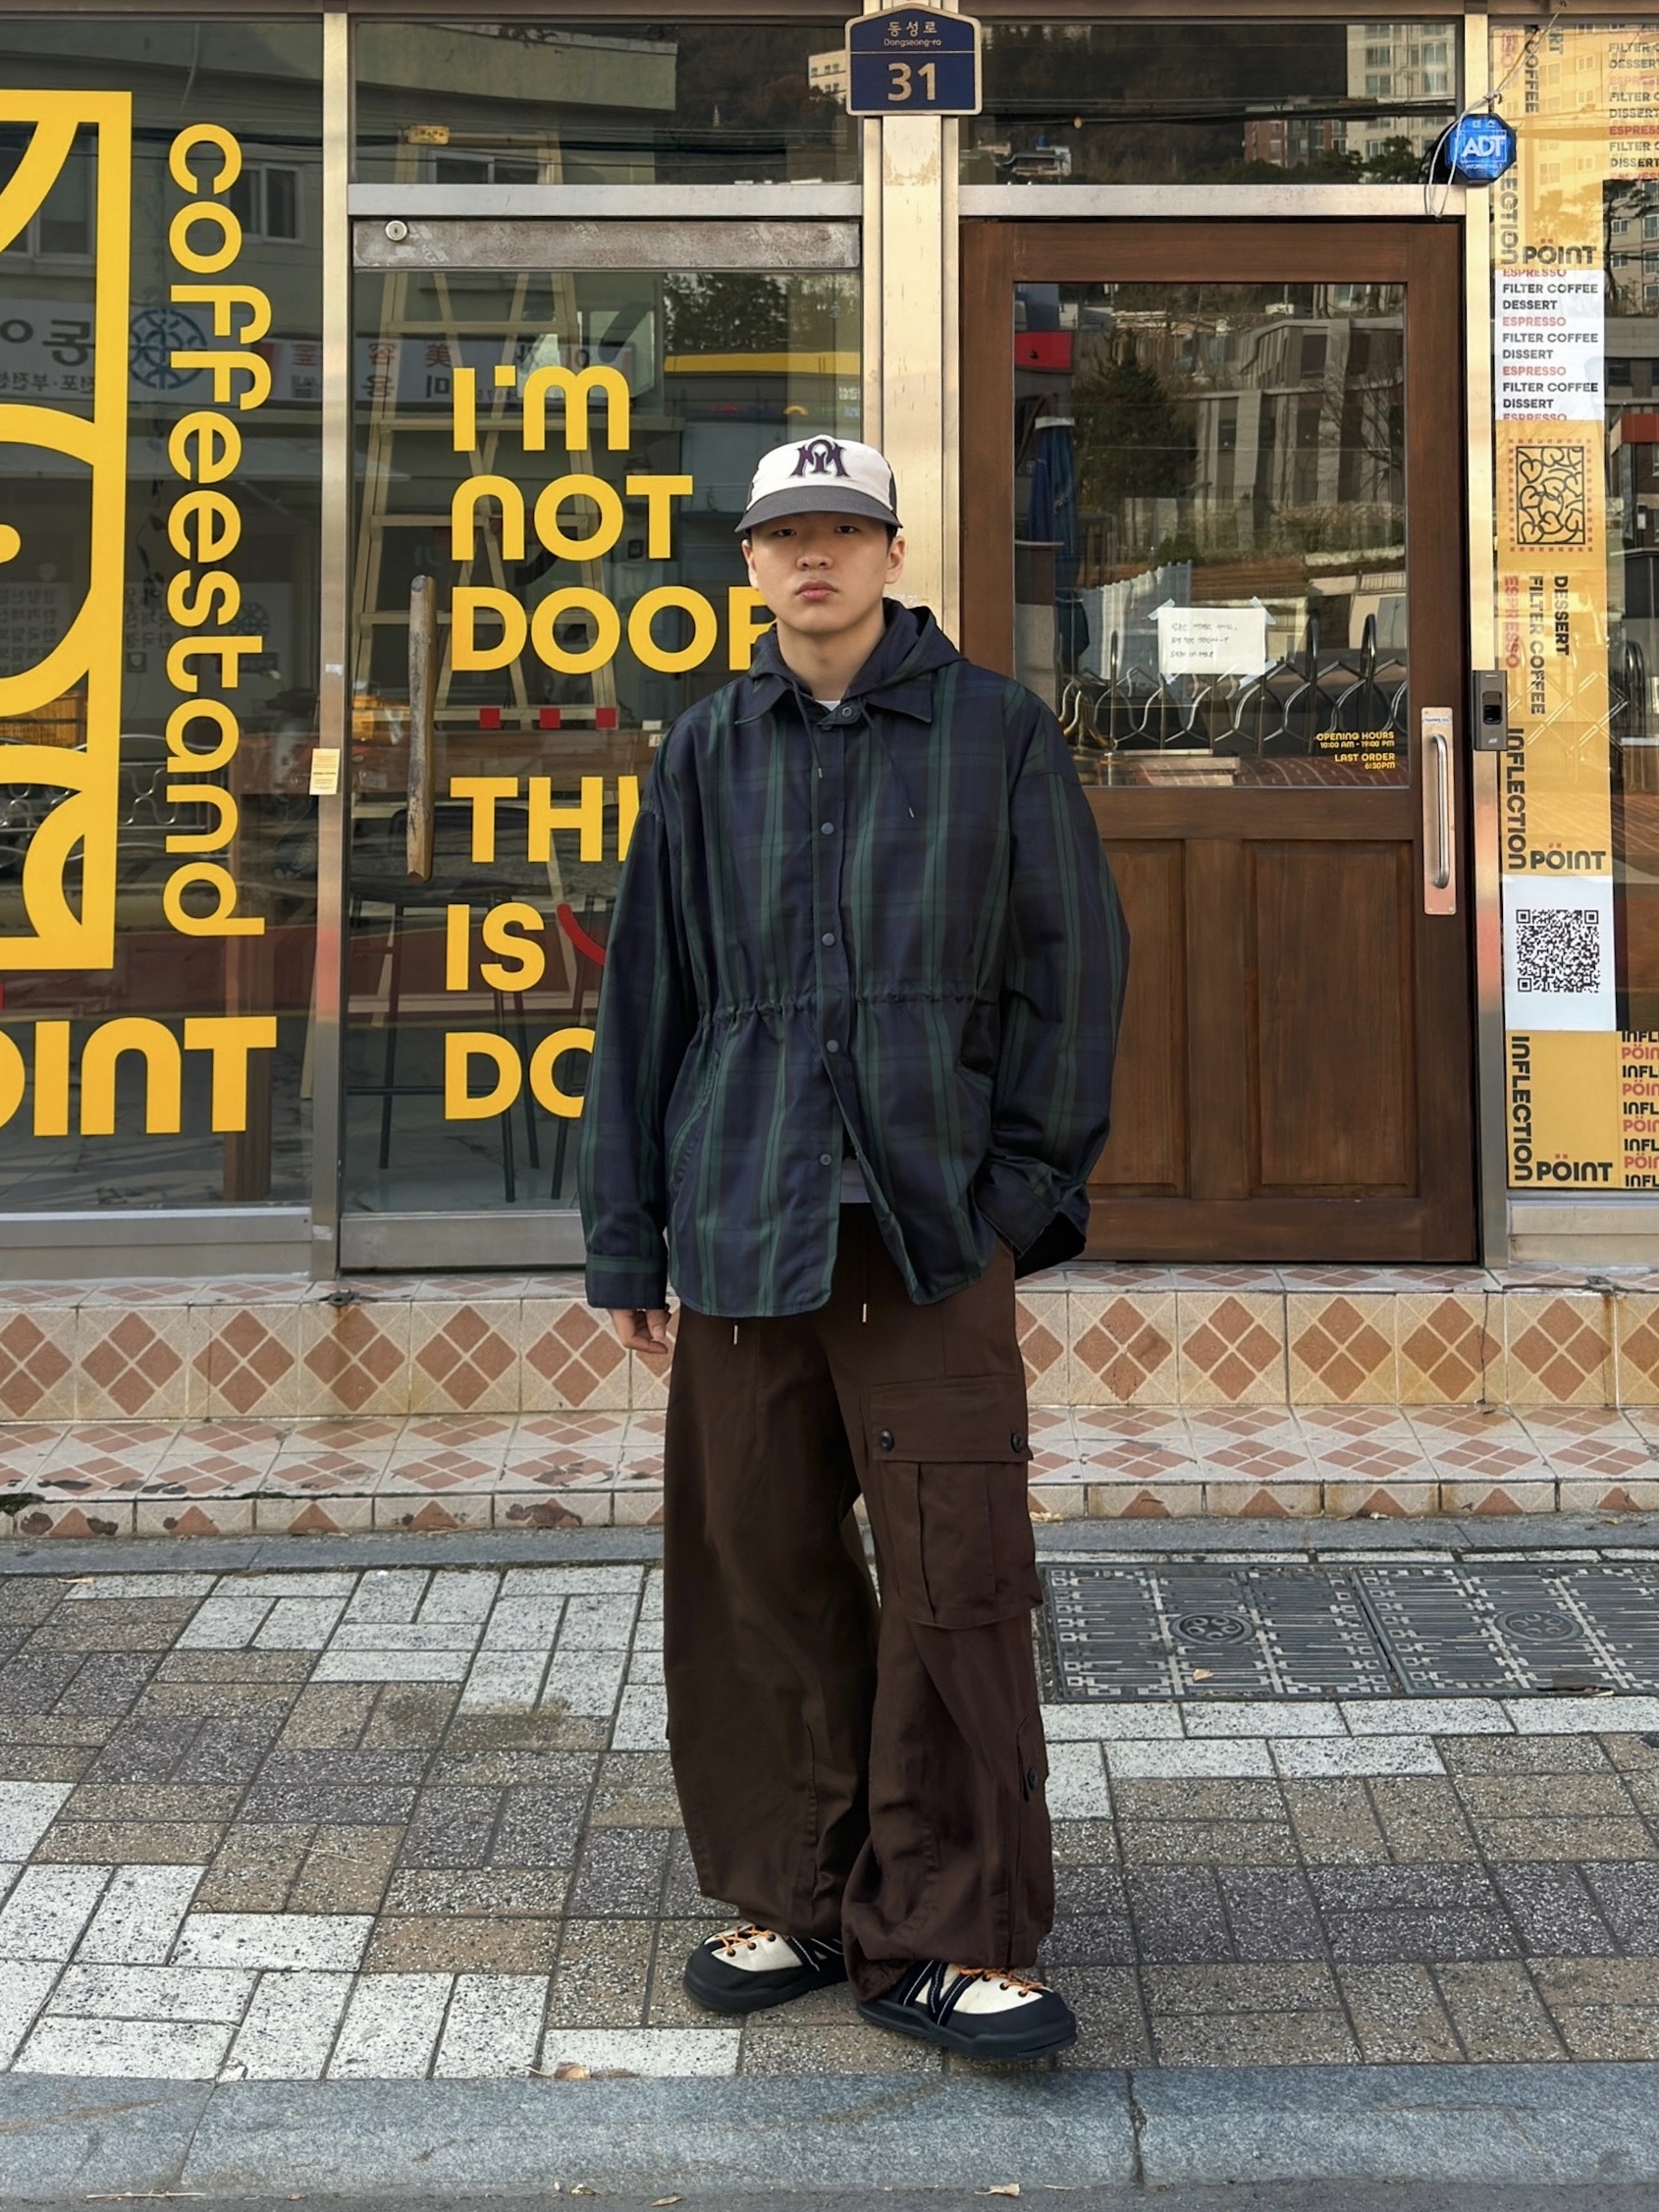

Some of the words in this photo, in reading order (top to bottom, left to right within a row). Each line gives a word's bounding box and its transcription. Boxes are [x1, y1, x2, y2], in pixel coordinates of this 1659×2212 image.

[887, 21, 937, 37] 동성로
[883, 38, 942, 48] Dongseong-ro
[887, 62, 937, 102] 31
[1609, 92, 1650, 102] FILTER
[1609, 125, 1659, 135] ESPRESS
[1461, 135, 1506, 157] ADT
[1609, 141, 1650, 151] FILTER
[1503, 284, 1544, 294] FILTER
[1547, 284, 1598, 294] COFFEE
[1503, 300, 1558, 310] DESSERT
[1503, 317, 1567, 327] ESPRESSO
[1503, 333, 1544, 343] FILTER
[1547, 333, 1598, 343] COFFEE
[1502, 350, 1554, 359] DISSERT
[1503, 366, 1567, 376] ESPRESSO
[1503, 382, 1544, 392] FILTER
[1547, 382, 1598, 392] COFFEE
[1503, 399, 1554, 408] DISSERT
[163, 124, 271, 937] coffeestand
[1528, 575, 1544, 635] FILTER
[1554, 575, 1570, 656] DESSERT
[1529, 640, 1546, 715] COFFEE
[1316, 731, 1360, 741] OPENING
[1362, 731, 1395, 740] HOURS
[1334, 753, 1359, 762] LAST
[1362, 752, 1395, 762] ORDER
[450, 776, 639, 862] THI
[446, 902, 546, 992] IS
